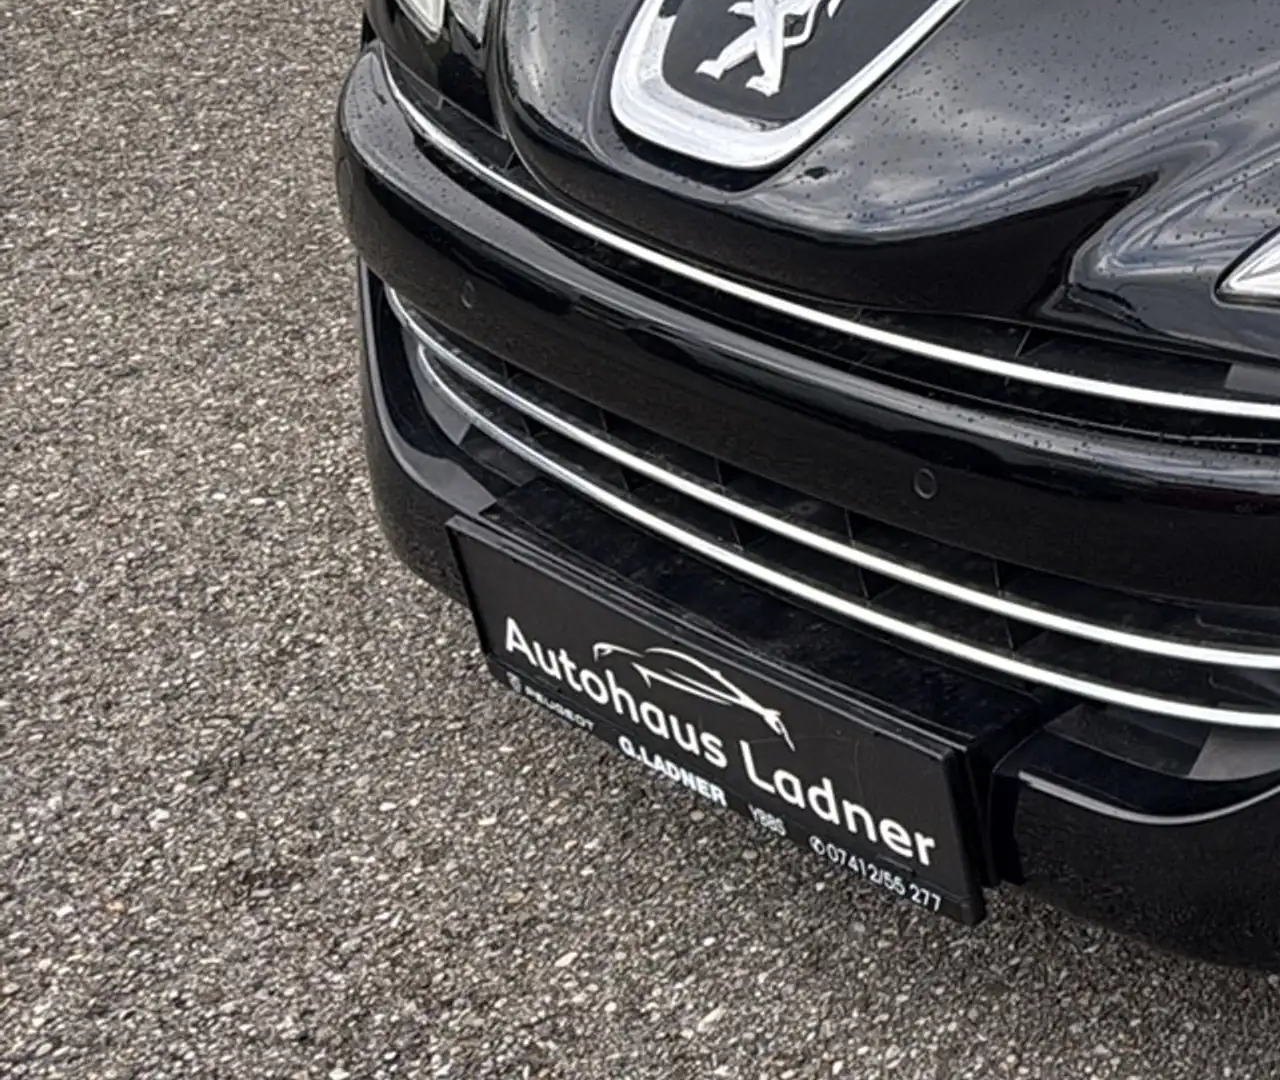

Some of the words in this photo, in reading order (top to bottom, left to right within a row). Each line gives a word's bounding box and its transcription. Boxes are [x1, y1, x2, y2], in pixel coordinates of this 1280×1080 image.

[506, 616, 728, 768] Autohaus
[740, 739, 936, 866] Ladner
[910, 883, 942, 912] 277
